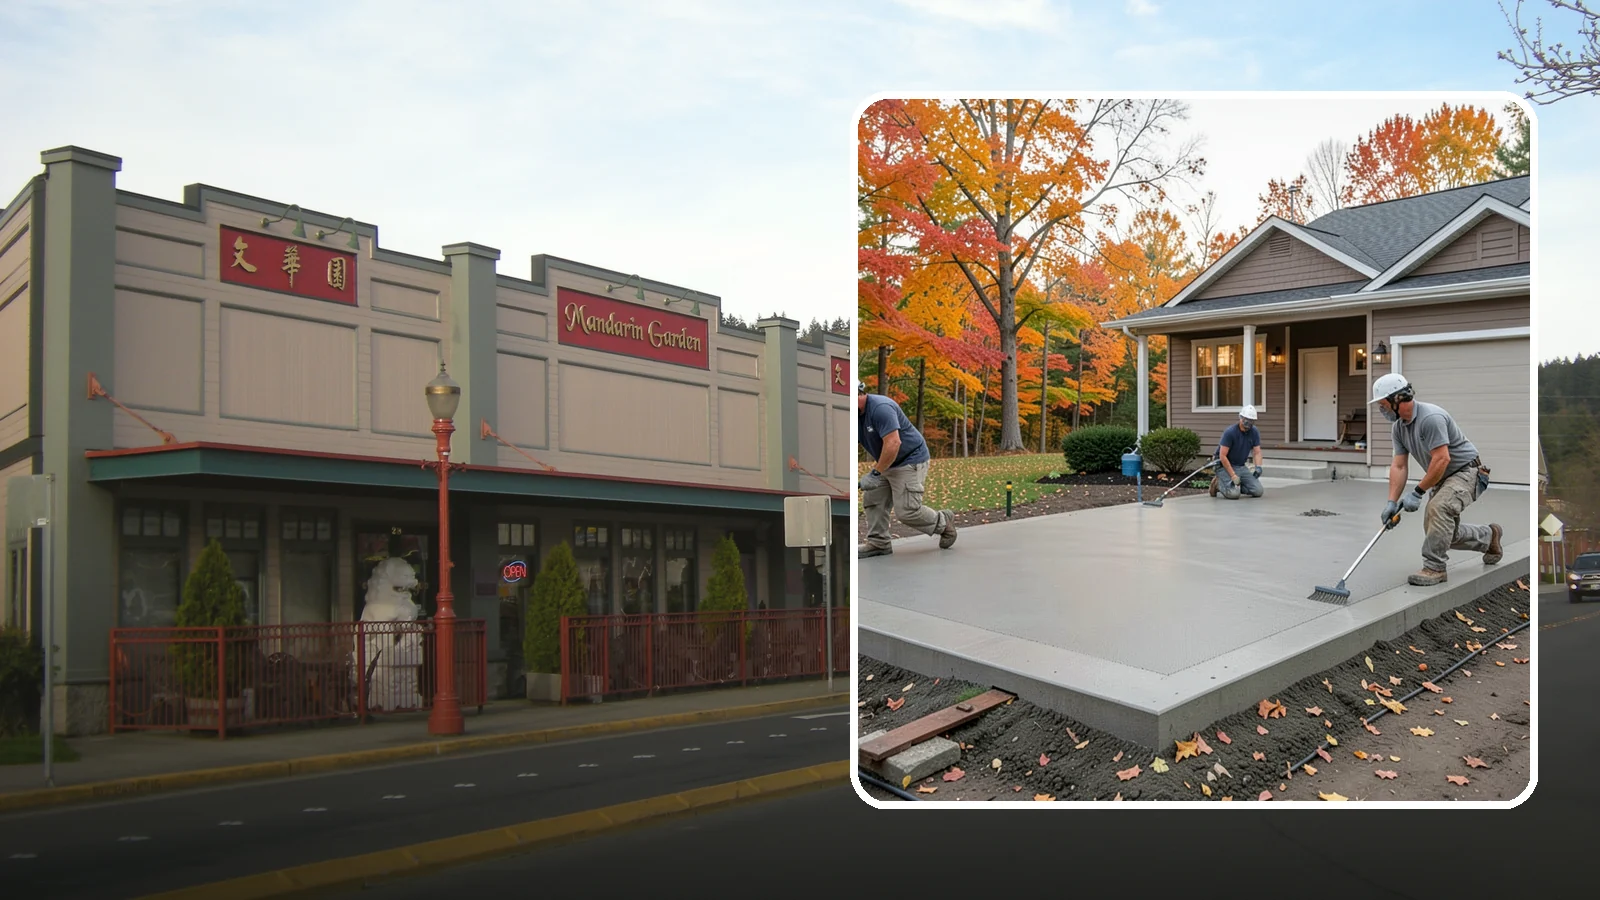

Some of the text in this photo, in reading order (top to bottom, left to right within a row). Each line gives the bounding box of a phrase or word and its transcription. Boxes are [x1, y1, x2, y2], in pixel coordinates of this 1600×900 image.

[232, 236, 346, 290] 文華園
[565, 303, 701, 352] Mandarin Garden
[503, 565, 527, 578] OPEN
